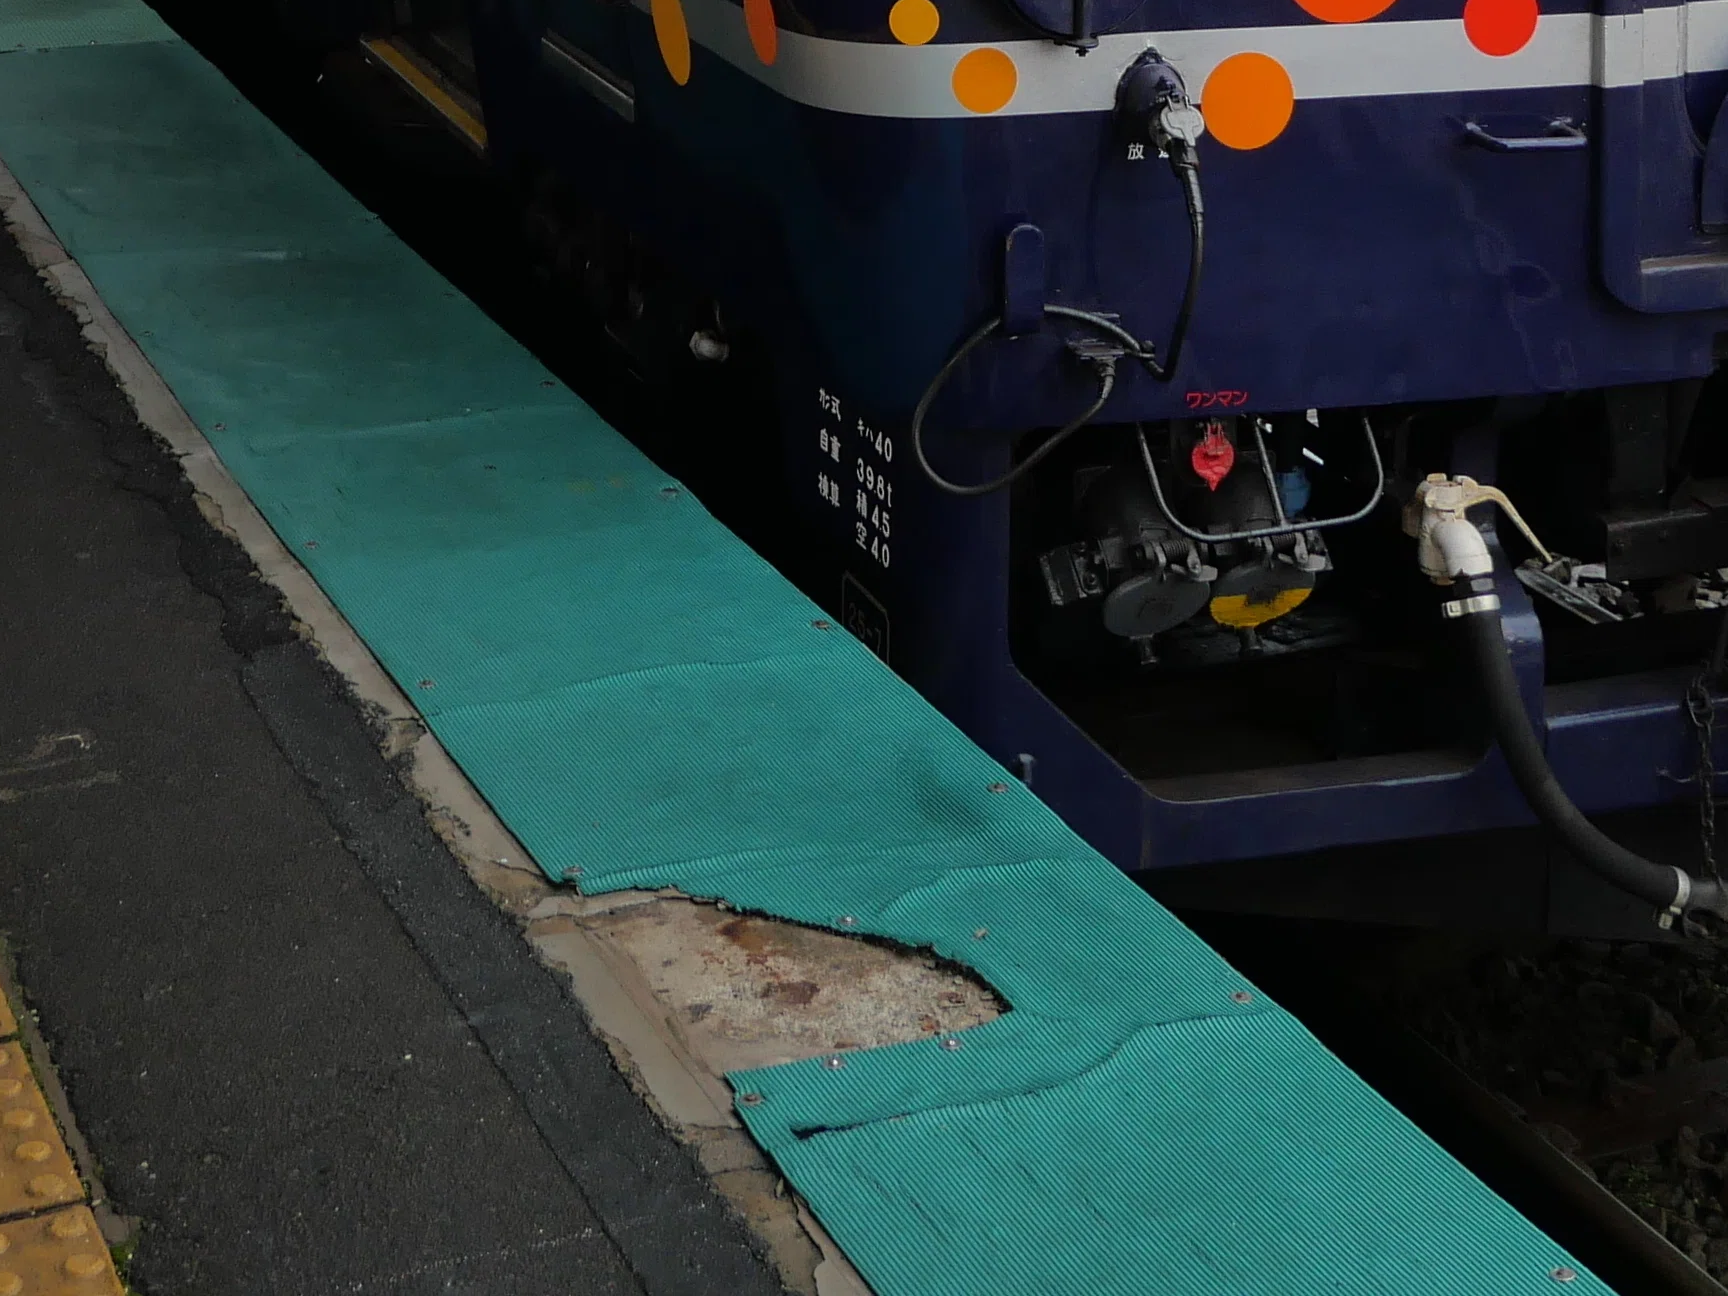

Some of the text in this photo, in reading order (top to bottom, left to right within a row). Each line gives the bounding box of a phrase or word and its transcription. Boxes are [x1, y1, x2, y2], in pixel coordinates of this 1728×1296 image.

[1186, 389, 1249, 409] ワンマン
[818, 386, 894, 463] 形式 キハ40
[819, 426, 893, 508] 自重 39.8t
[871, 504, 891, 539] 4.5
[870, 536, 891, 569] 4.0
